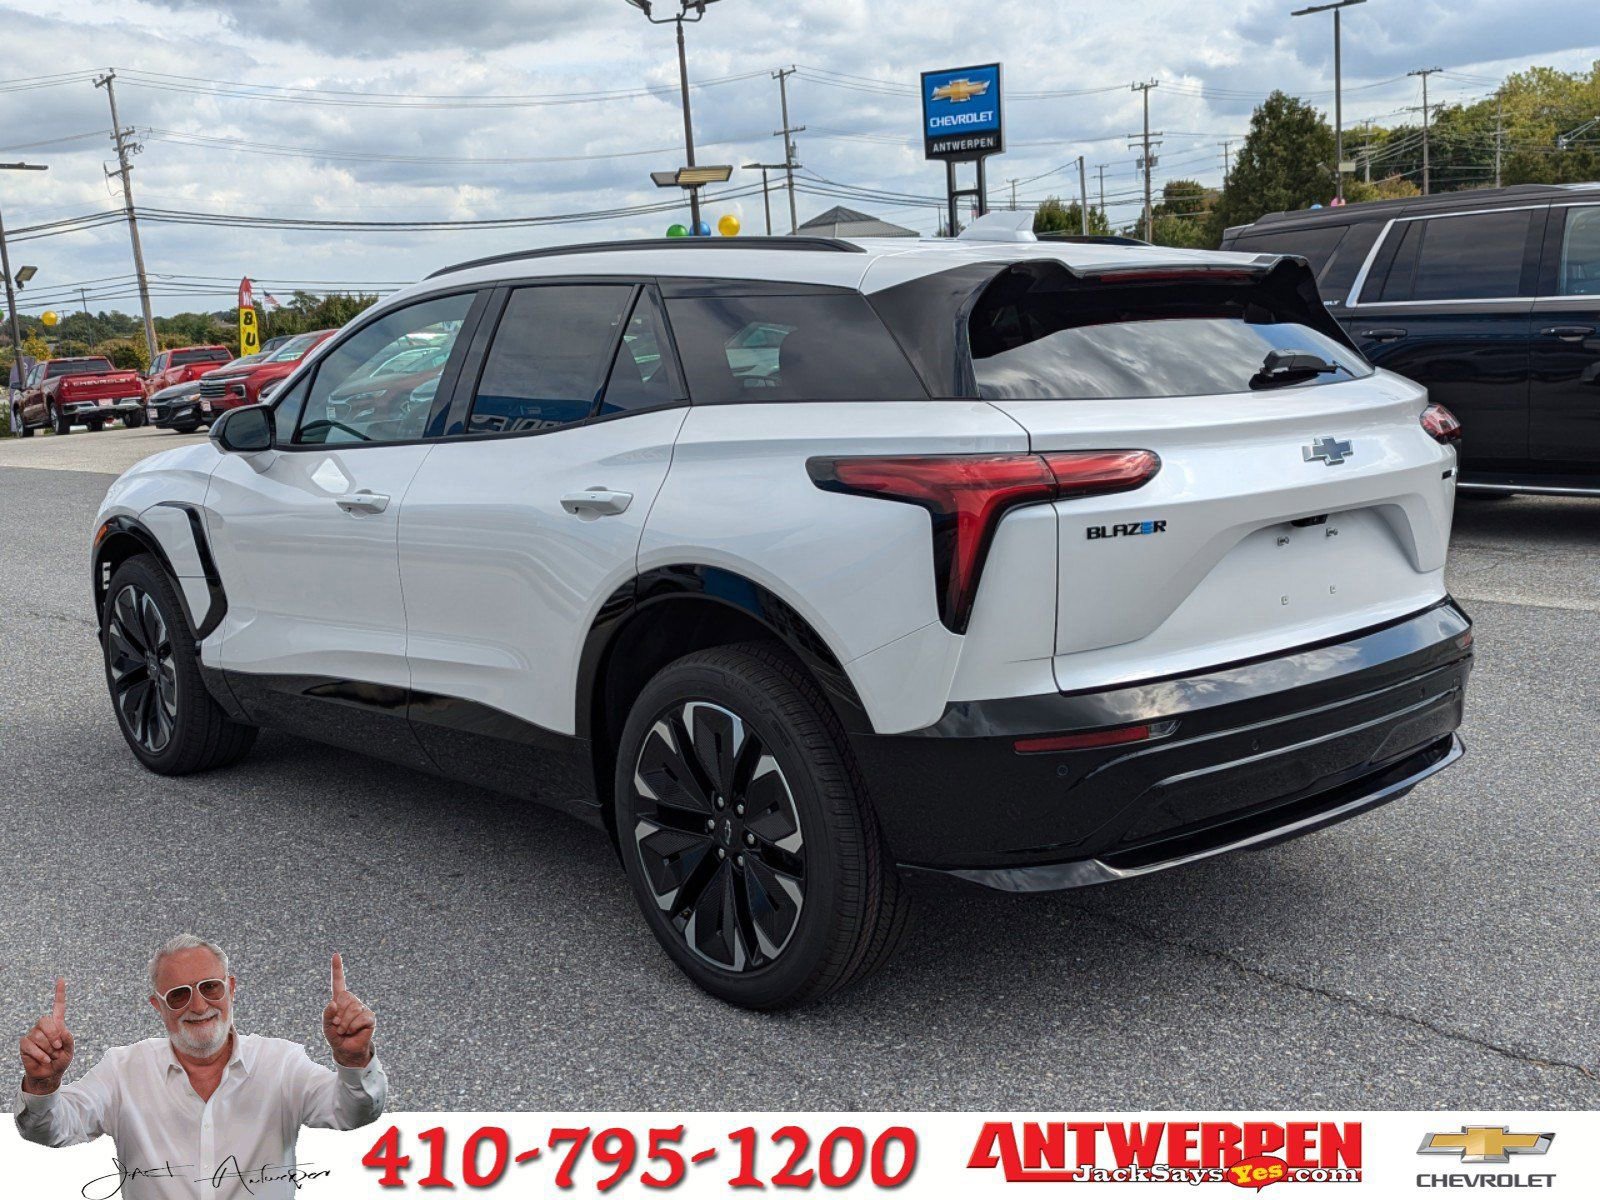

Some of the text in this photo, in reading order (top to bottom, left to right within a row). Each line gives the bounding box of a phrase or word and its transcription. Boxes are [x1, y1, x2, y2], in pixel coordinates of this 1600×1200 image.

[929, 110, 994, 128] CHEVROLET
[933, 137, 994, 153] ANTWERPEN
[1086, 519, 1167, 540] BLAZER
